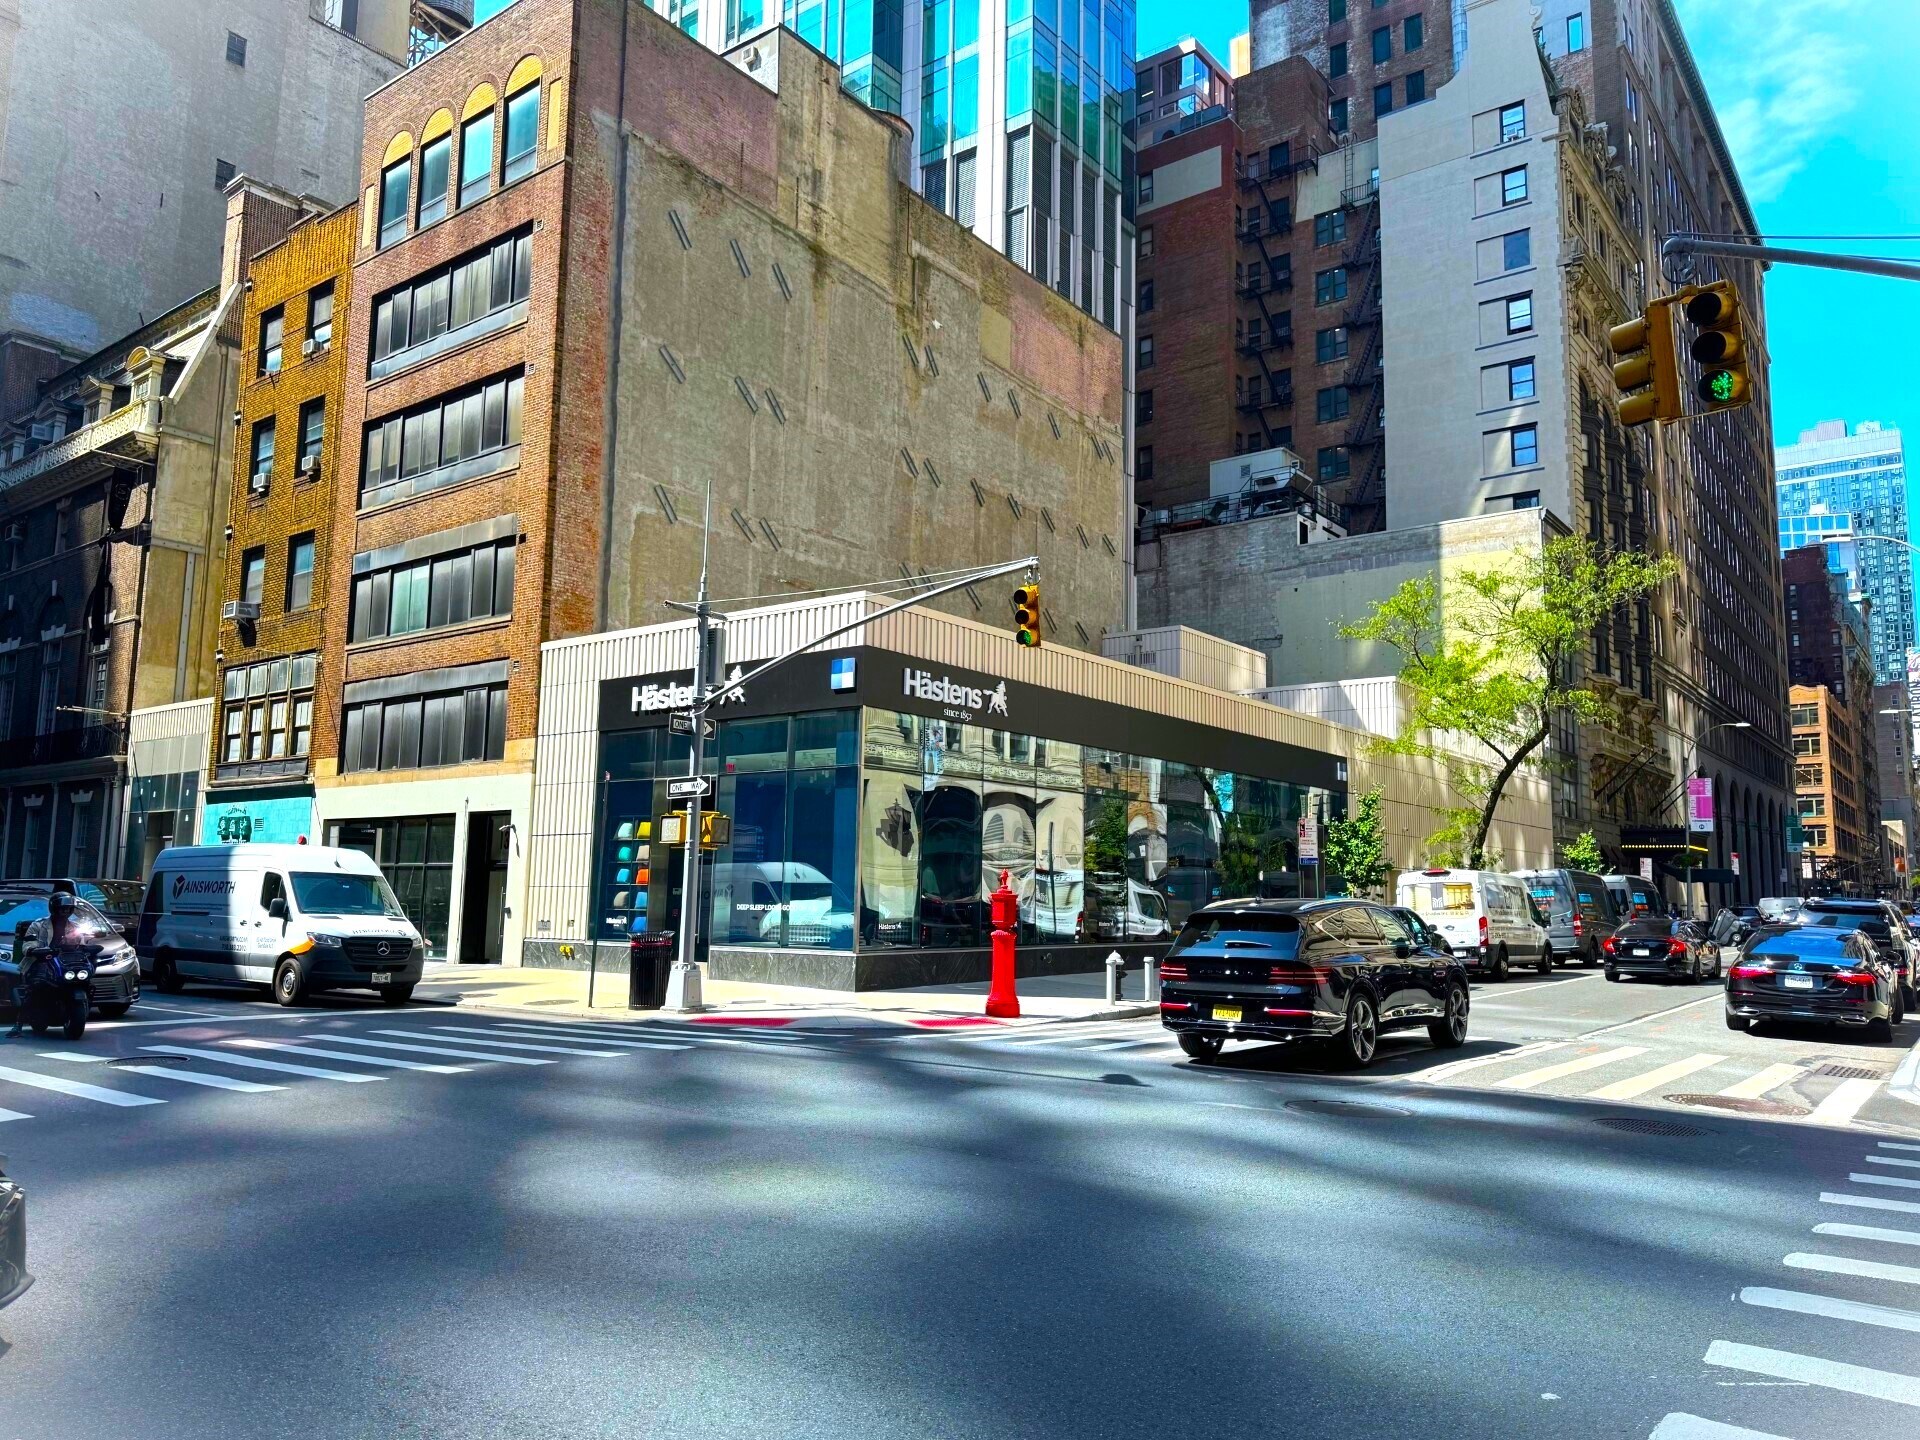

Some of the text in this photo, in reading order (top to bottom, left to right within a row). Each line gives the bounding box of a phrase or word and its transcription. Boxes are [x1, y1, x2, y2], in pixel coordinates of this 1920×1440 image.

[903, 667, 983, 709] Hästens
[943, 707, 973, 722] since 1852
[674, 719, 688, 729] ONE
[671, 781, 703, 792] ONE WAY
[185, 880, 237, 894] AINSWORTH
[736, 903, 750, 911] DEEP
